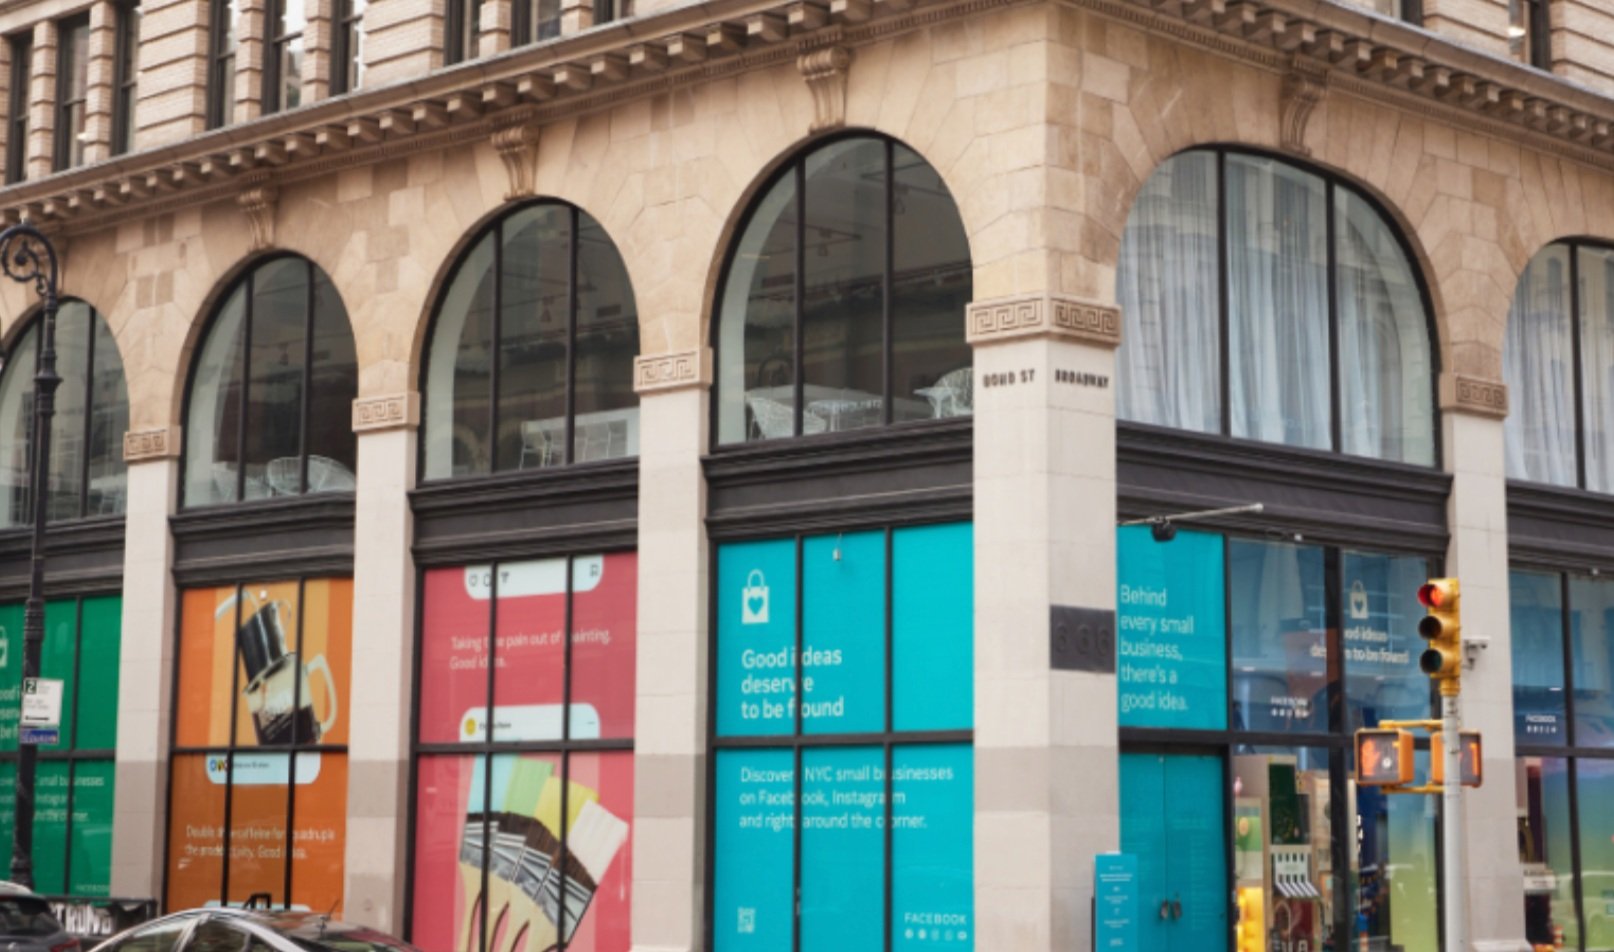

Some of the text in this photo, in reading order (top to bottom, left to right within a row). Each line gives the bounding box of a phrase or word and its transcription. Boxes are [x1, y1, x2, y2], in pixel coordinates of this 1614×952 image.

[983, 368, 1035, 388] BOND ST
[1055, 369, 1109, 388] BROADWAY
[1120, 584, 1167, 606] Behind
[1120, 615, 1194, 636] every small
[451, 635, 482, 652] Taking
[506, 632, 528, 650] pain
[530, 633, 548, 645] out
[551, 630, 561, 645] of
[569, 628, 612, 646] ainting.
[1120, 637, 1183, 661] business,
[450, 655, 476, 670] Good
[741, 646, 843, 669] Good ideas
[1121, 663, 1177, 684] there's a
[741, 674, 814, 694] deserve
[741, 696, 844, 719] to be found
[1121, 691, 1188, 713] good idea.
[741, 765, 953, 782] Discover NYC small businesses
[739, 790, 906, 807] on Facebook, Instagram
[186, 824, 215, 838] Double
[739, 813, 927, 831] and right around the corner.
[258, 844, 280, 858] Good
[904, 912, 967, 924] FACEBOOK
